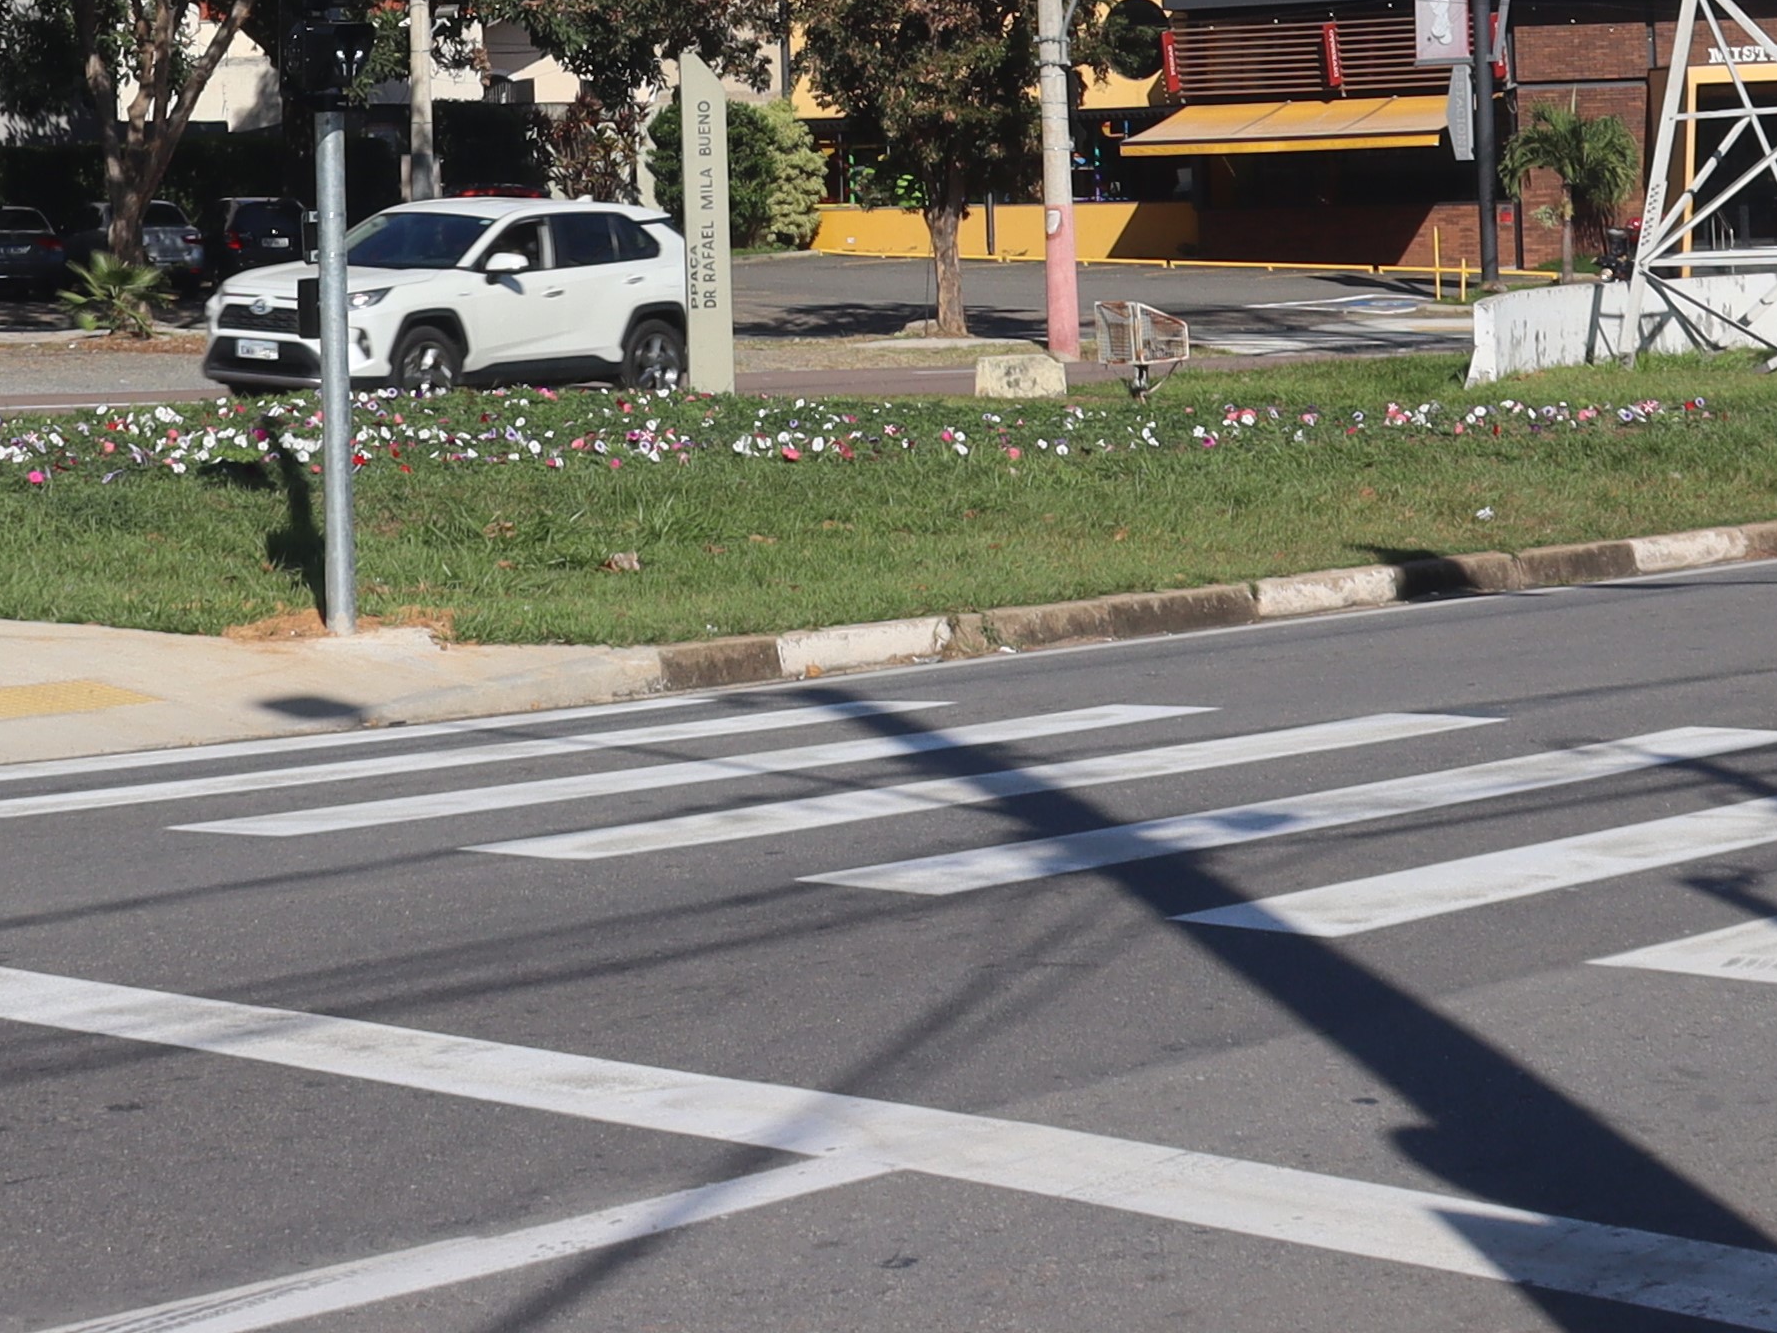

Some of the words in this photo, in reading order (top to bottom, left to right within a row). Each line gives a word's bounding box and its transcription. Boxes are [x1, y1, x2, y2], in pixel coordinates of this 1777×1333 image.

[697, 100, 712, 157] BUENO
[700, 167, 713, 210] MILA
[702, 220, 716, 283] RAFAEL
[703, 289, 717, 309] DR
